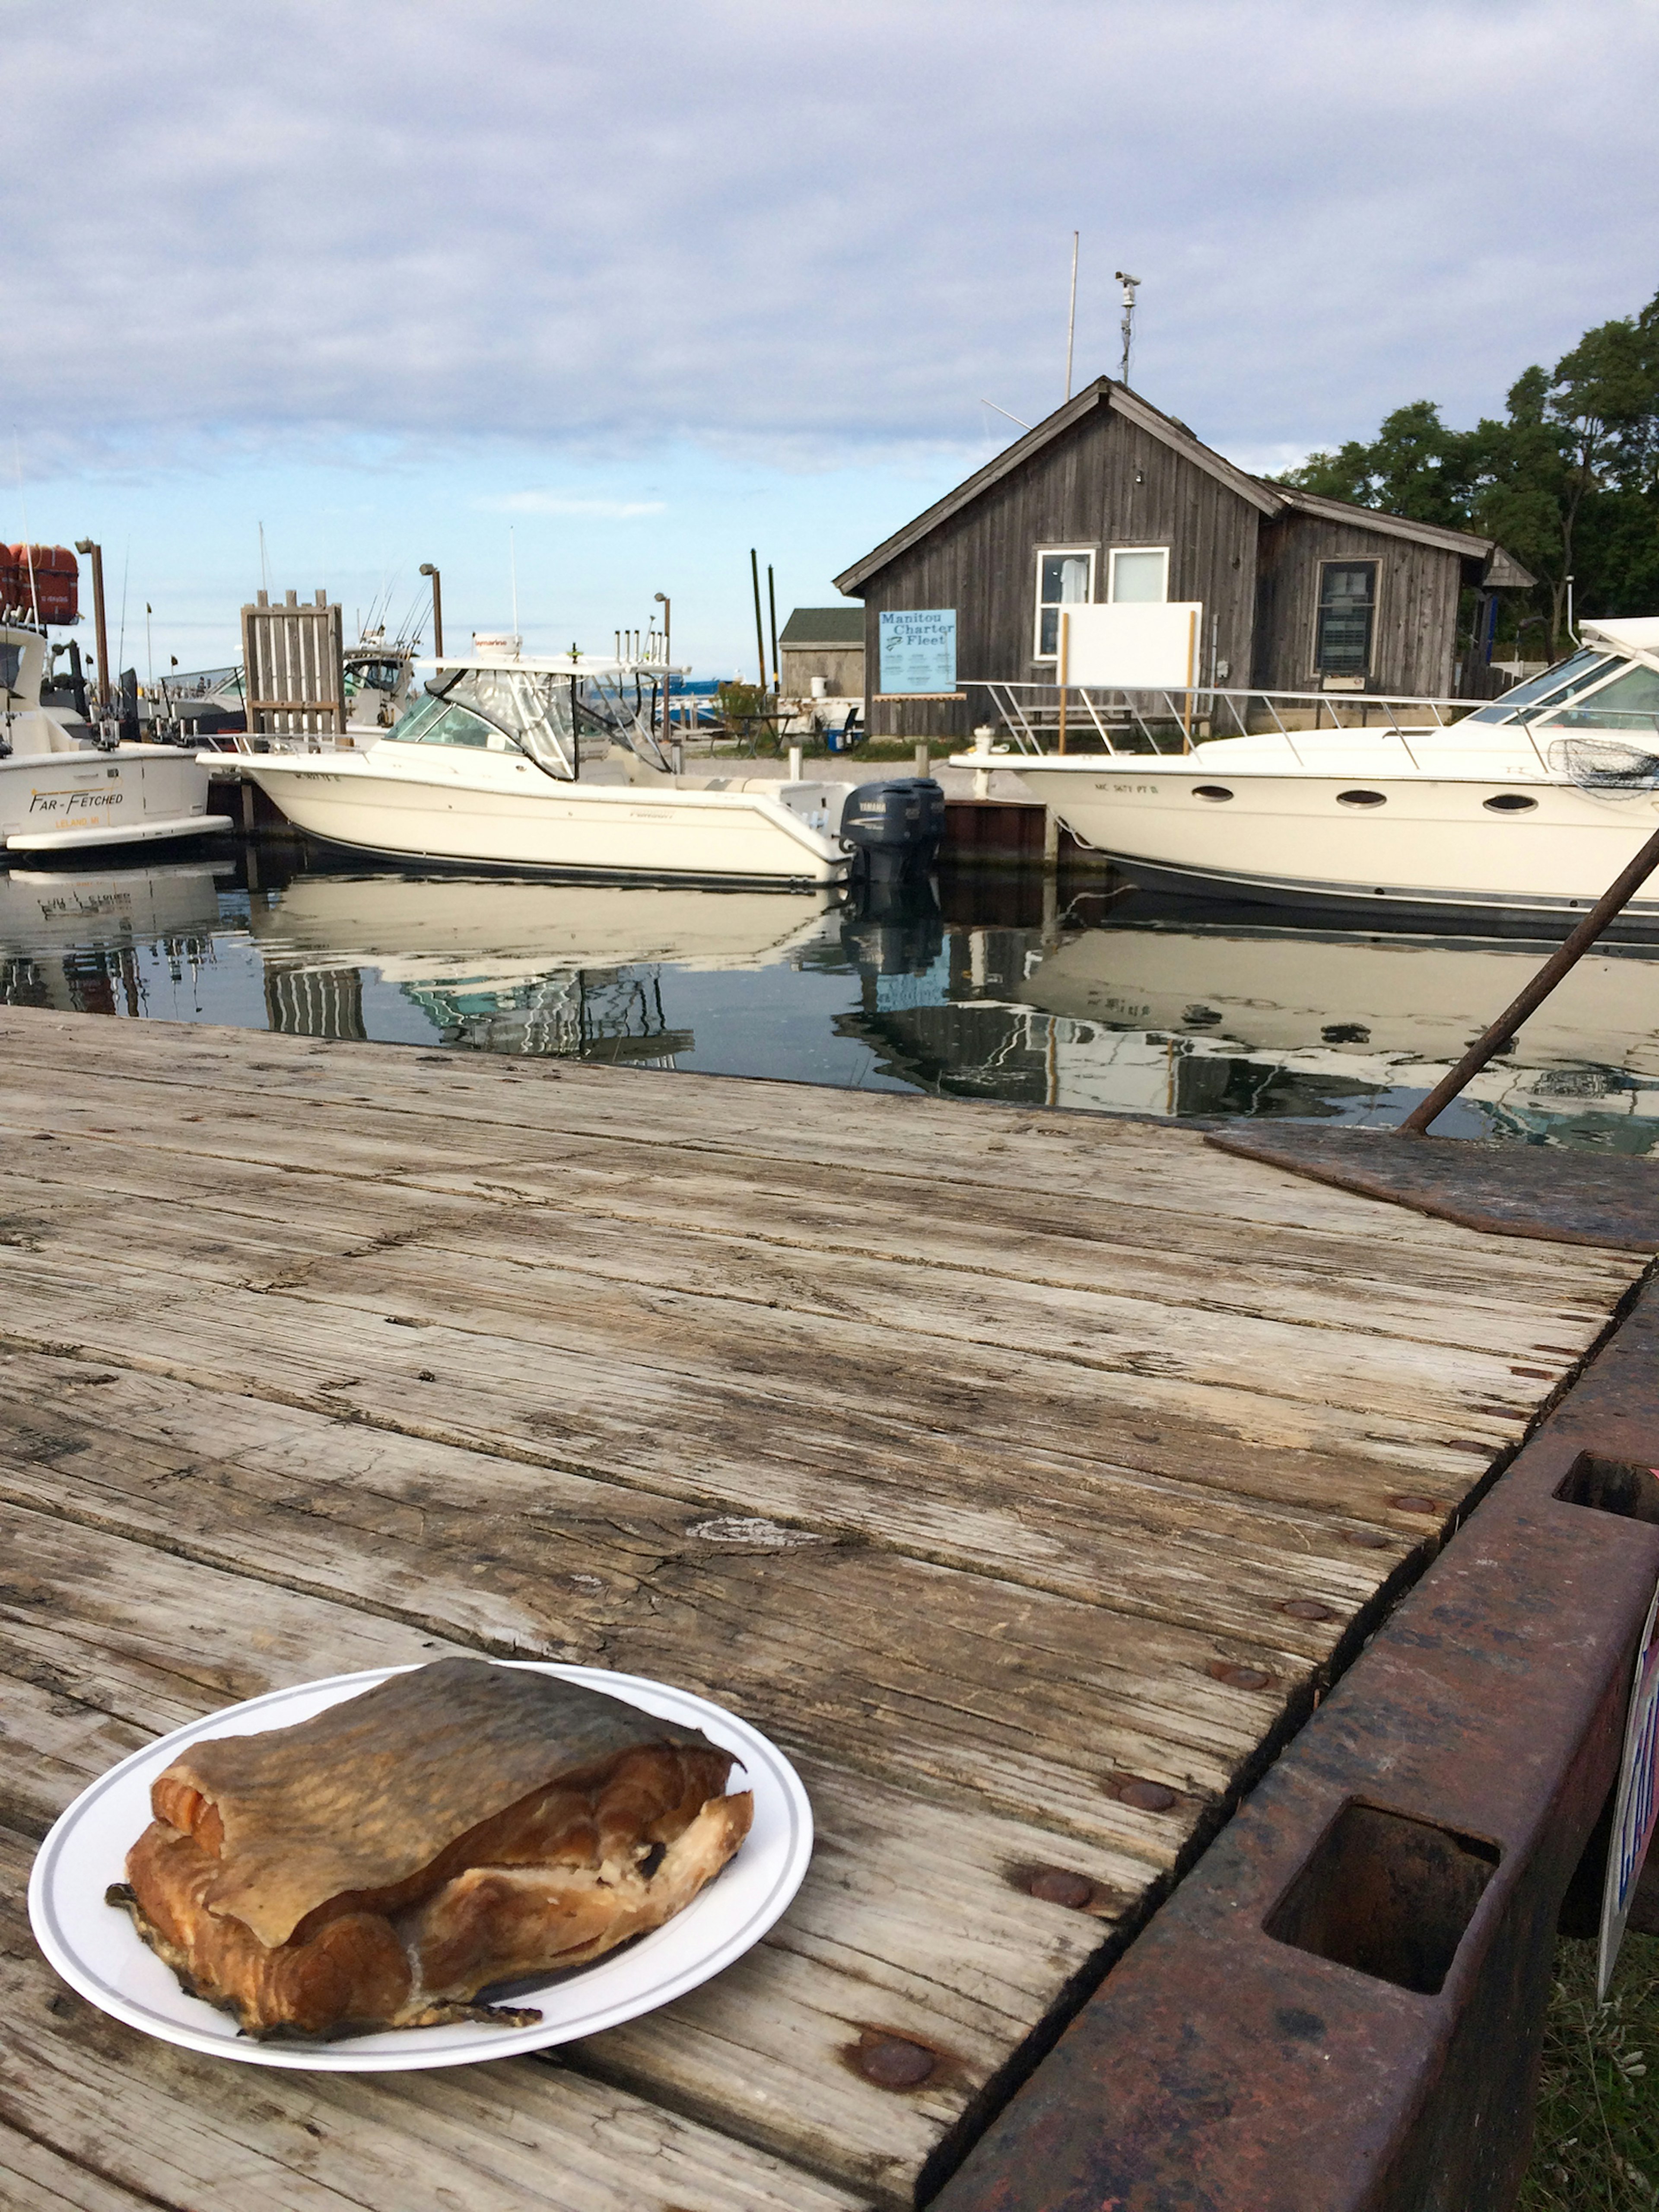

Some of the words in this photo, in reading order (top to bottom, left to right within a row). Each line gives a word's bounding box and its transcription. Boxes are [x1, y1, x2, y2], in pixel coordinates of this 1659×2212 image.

[882, 613, 941, 624] Manitou
[894, 624, 954, 635] Charter
[907, 635, 946, 646] Fleet
[859, 802, 886, 813] YAMAHA
[55, 818, 87, 829] LELAND
